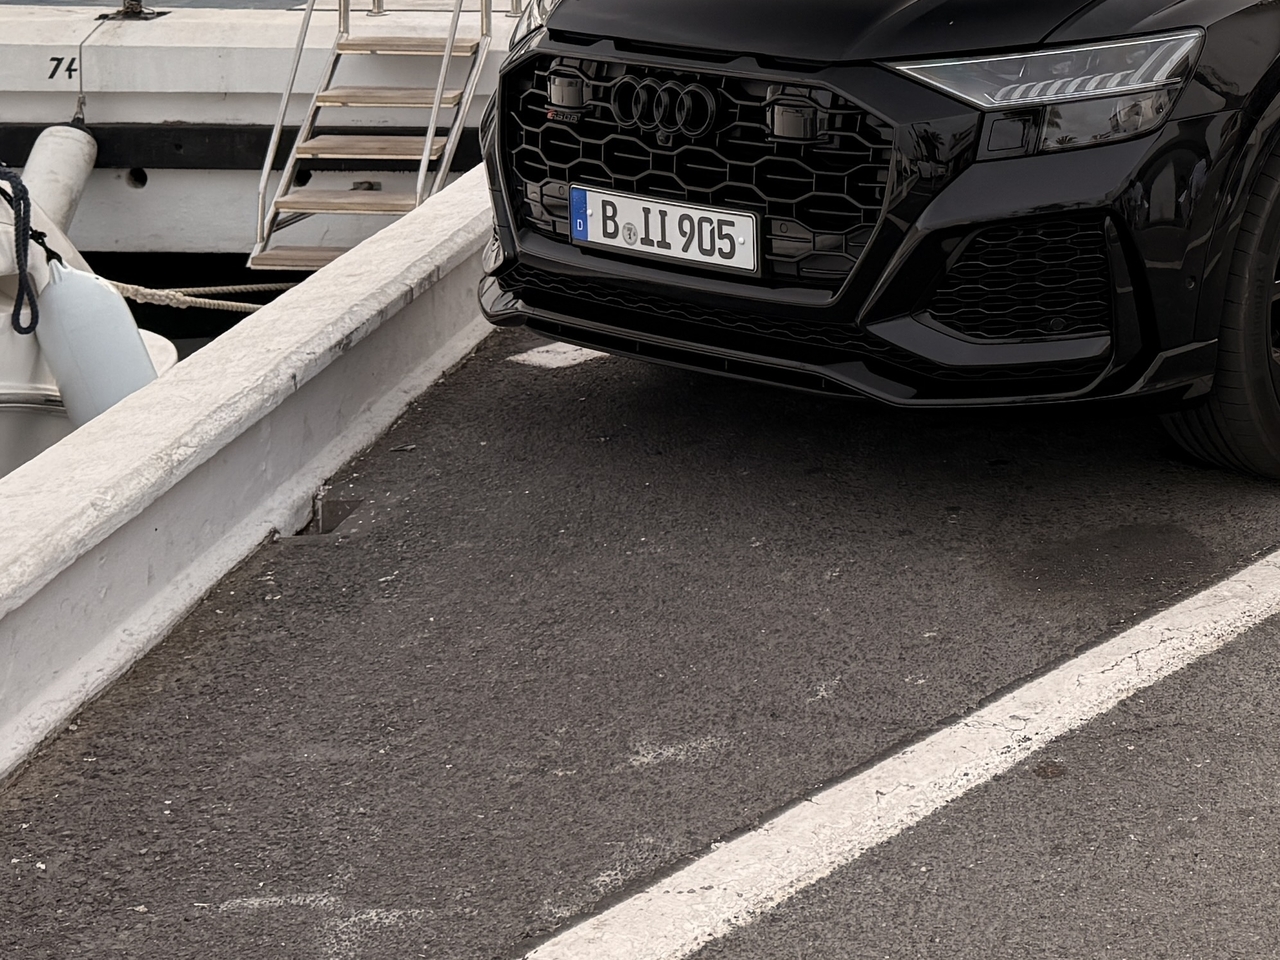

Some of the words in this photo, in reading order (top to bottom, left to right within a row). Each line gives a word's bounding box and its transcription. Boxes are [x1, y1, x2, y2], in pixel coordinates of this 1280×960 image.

[48, 56, 78, 79] 74
[577, 219, 583, 231] D
[602, 200, 619, 239] B
